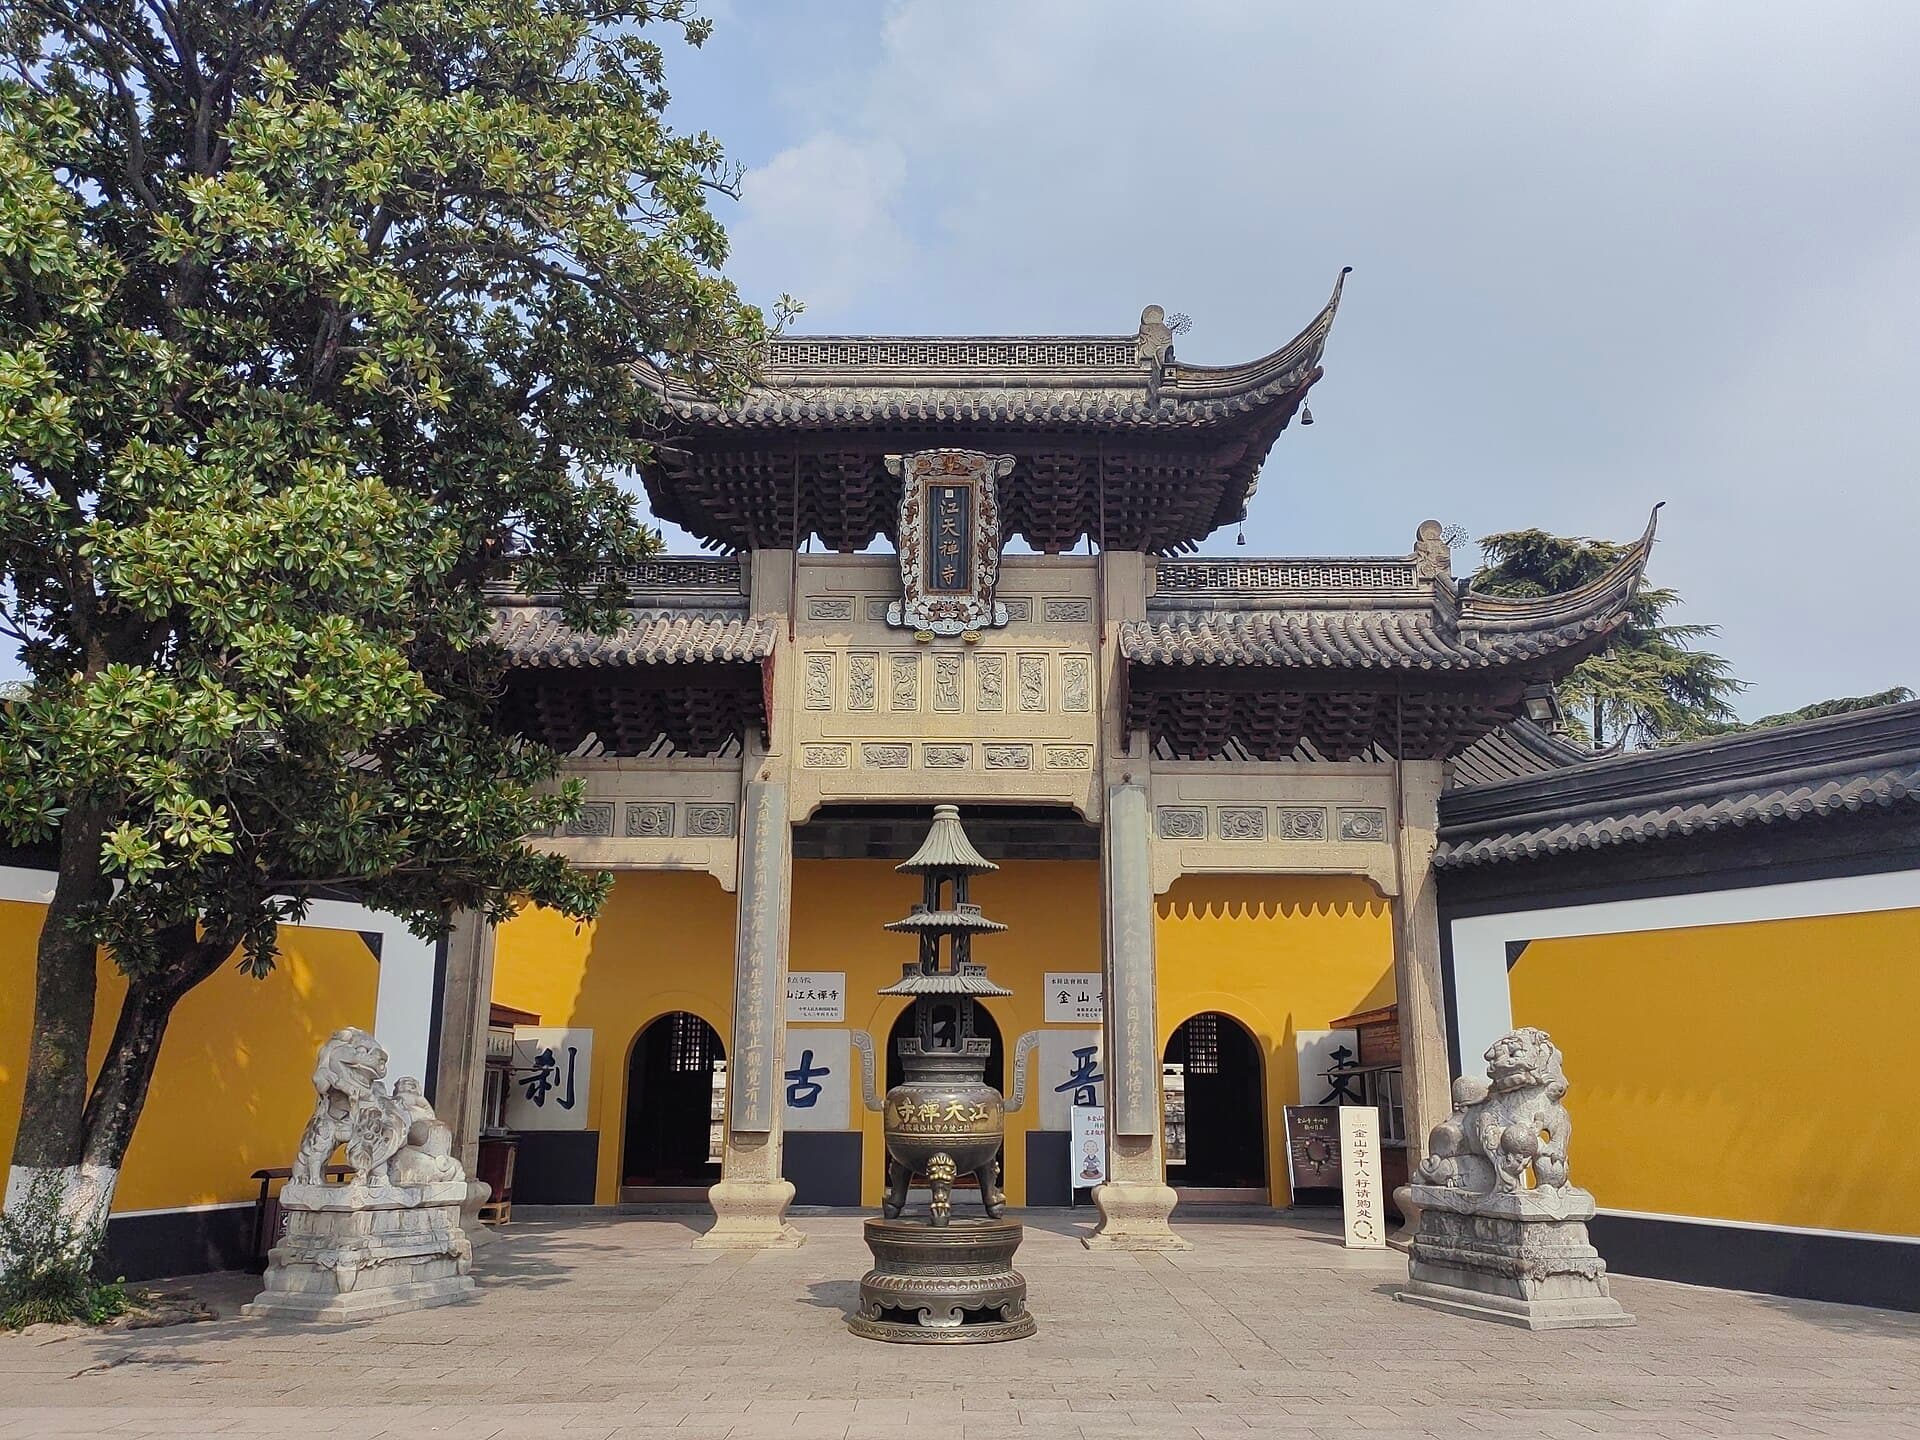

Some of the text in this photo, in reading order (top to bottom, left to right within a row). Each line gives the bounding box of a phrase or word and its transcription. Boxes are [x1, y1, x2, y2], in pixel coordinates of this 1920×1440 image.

[785, 1049, 830, 1108] 古
[1352, 1128, 1373, 1219] 金山寺十八籽请购处
